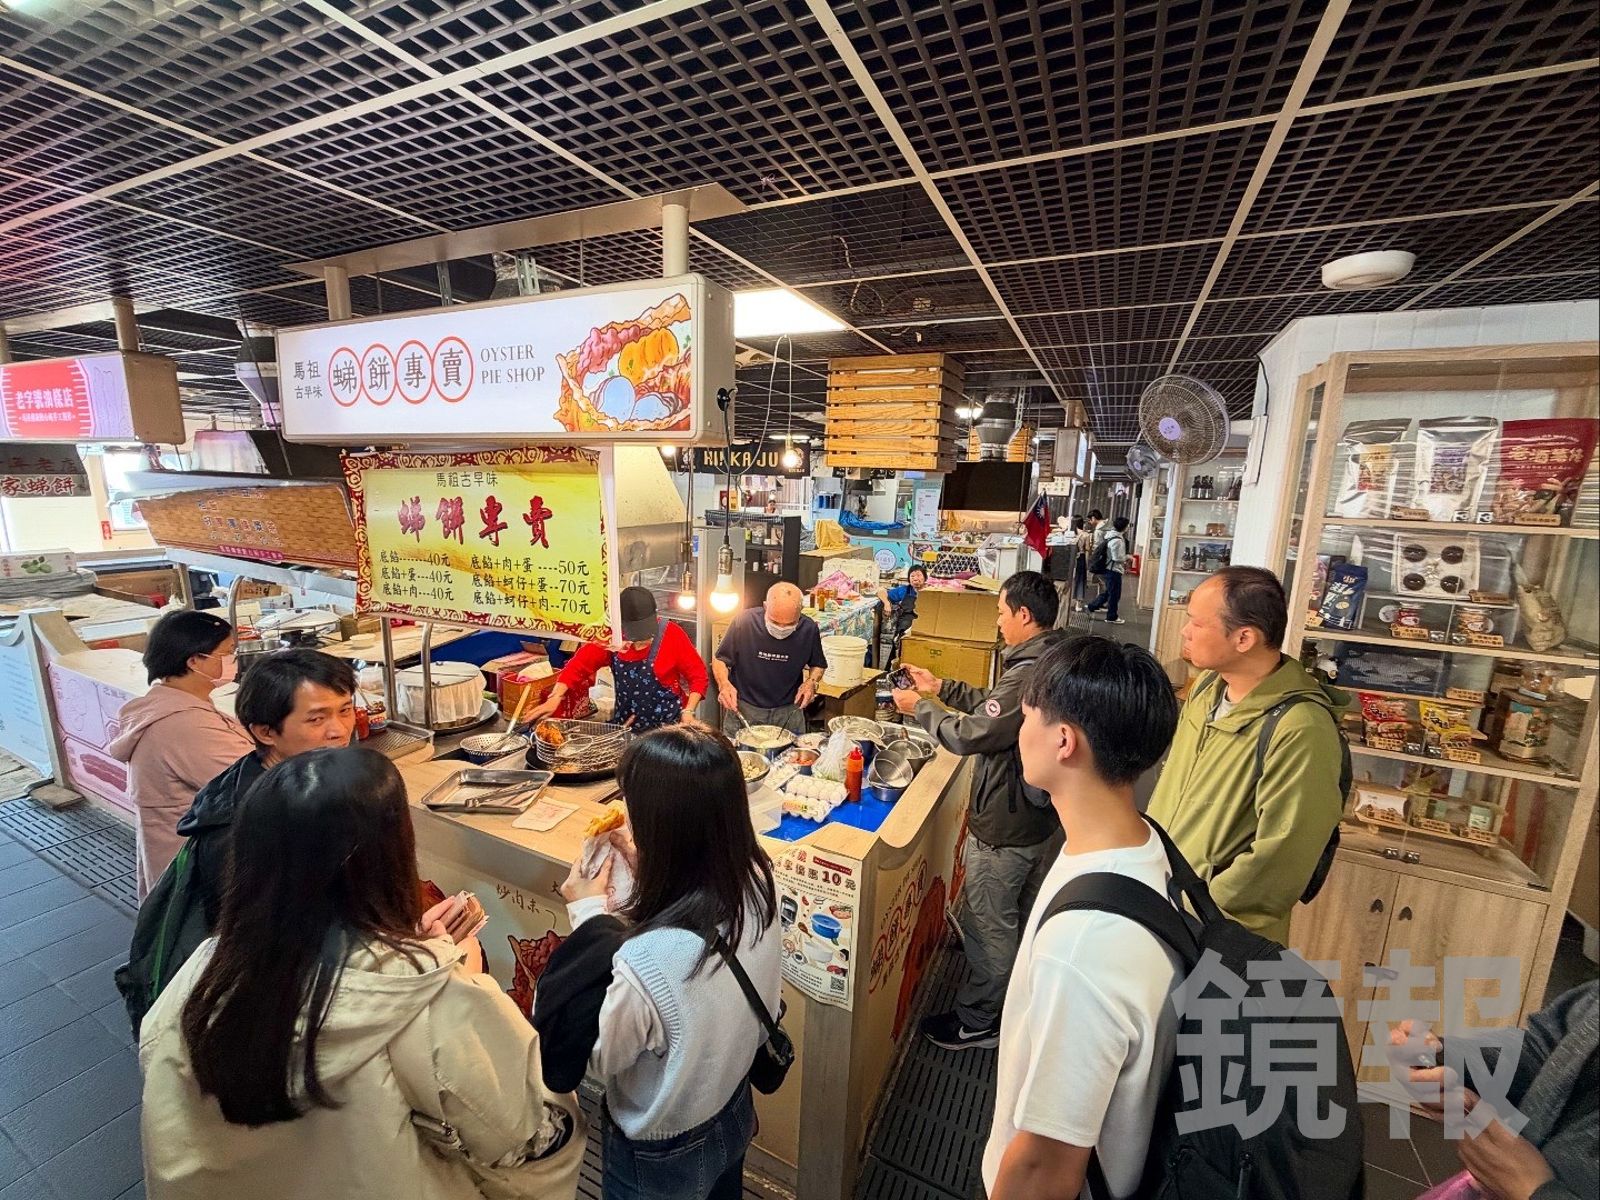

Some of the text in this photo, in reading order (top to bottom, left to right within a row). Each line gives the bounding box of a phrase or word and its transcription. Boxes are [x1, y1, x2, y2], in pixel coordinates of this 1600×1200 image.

[480, 343, 535, 363] OYSTER
[293, 359, 322, 380] 馬祖
[481, 366, 546, 385] PIE SHOP
[294, 384, 324, 400] 古早味
[436, 471, 499, 488] 馬祖古早味
